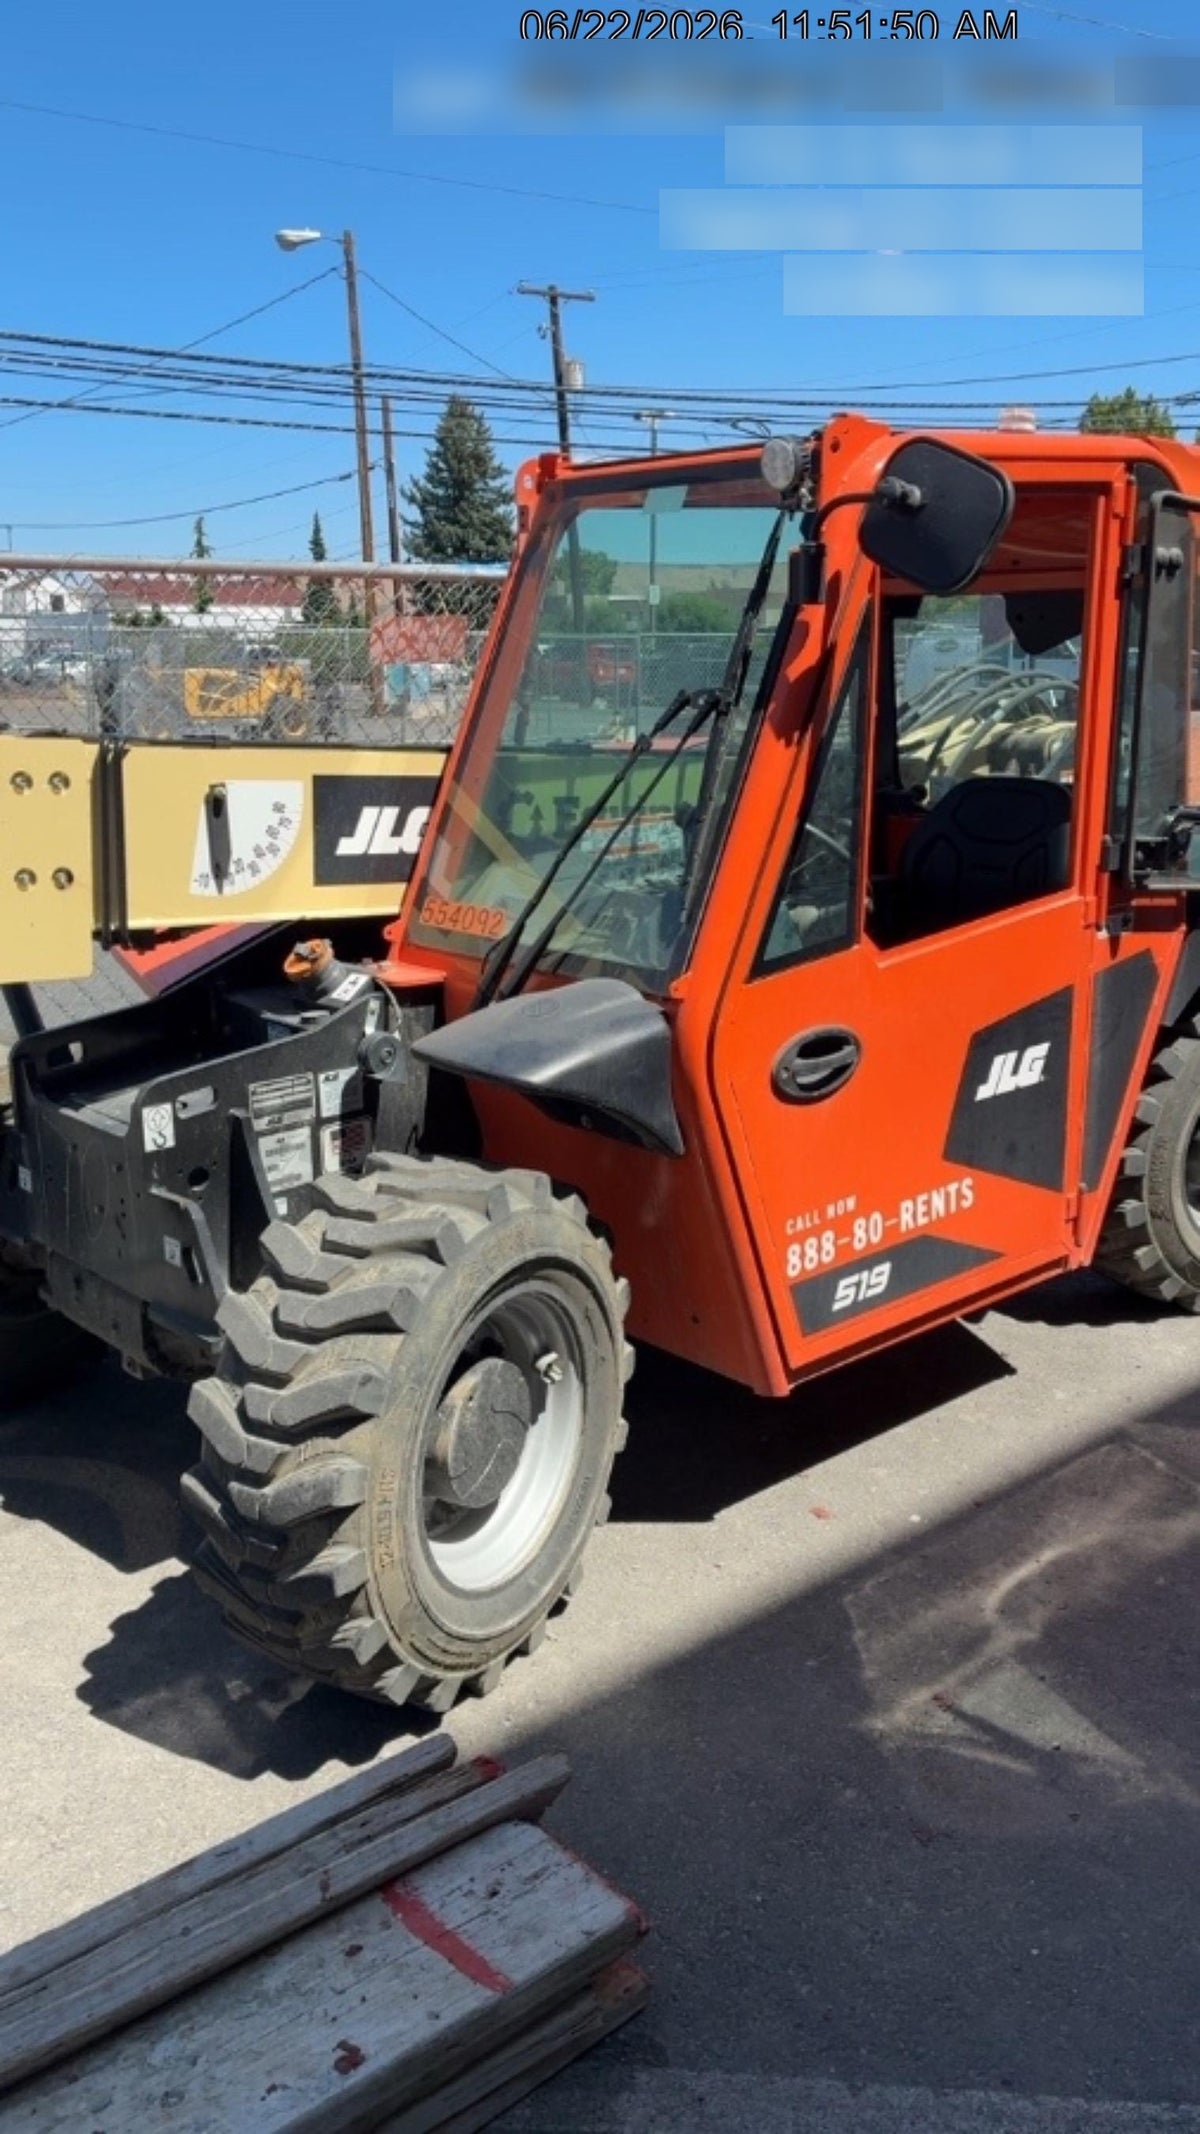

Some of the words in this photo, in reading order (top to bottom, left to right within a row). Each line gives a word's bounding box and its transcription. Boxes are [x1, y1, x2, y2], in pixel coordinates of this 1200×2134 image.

[424, 899, 504, 936] 554092
[974, 1041, 1052, 1102] JLG
[786, 1209, 821, 1236] CALL
[827, 1195, 857, 1219] NOW
[787, 1177, 975, 1277] 888-80-RENTS
[832, 1261, 892, 1312] 519
